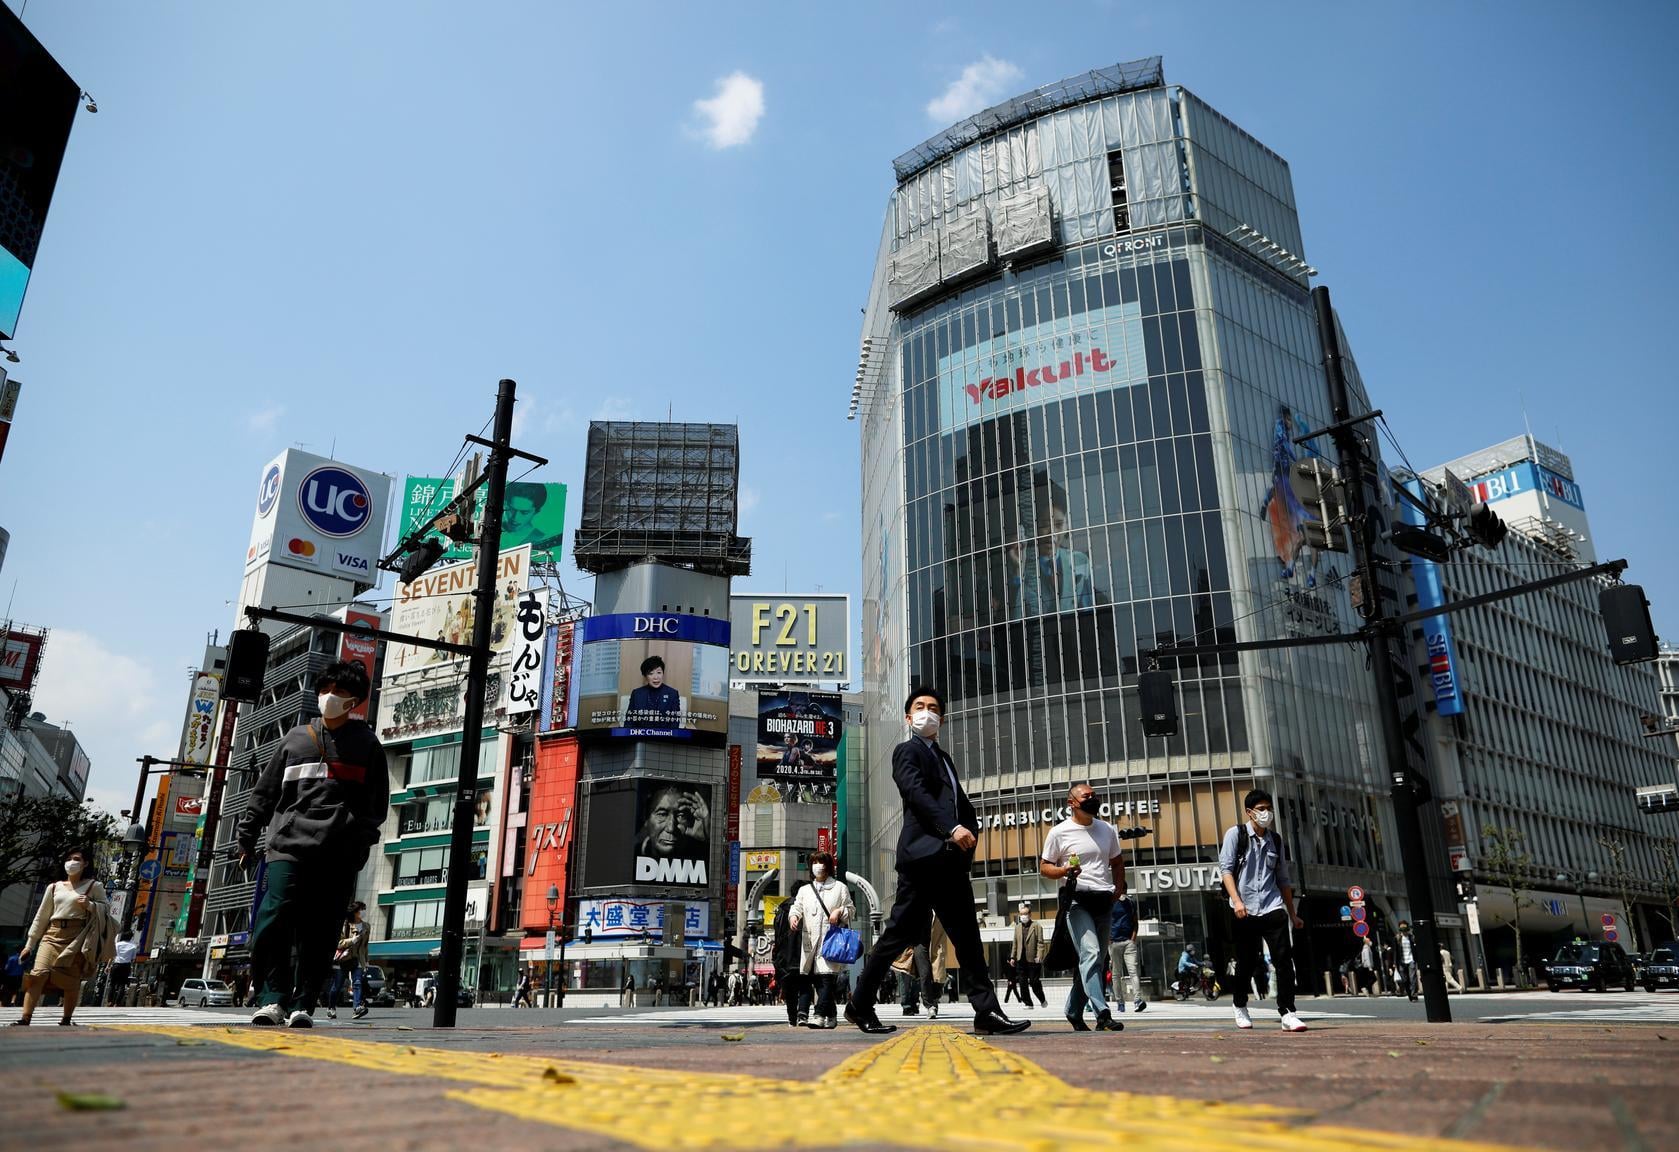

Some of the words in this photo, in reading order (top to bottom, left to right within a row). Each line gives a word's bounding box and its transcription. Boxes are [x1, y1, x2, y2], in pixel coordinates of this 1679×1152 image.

[1103, 235, 1163, 257] QFRONT
[964, 347, 1118, 405] Yakult
[338, 553, 368, 570] VISA
[401, 554, 521, 604] SEVENTEN
[633, 617, 679, 634] DHC
[752, 604, 817, 646] F21
[509, 592, 545, 708] もんじゃ
[823, 651, 844, 673] 21
[1426, 632, 1456, 700] SEIBU
[766, 719, 814, 734] BIOHAZARD
[976, 806, 1073, 829] STARBUCKS
[1097, 799, 1160, 818] OFFEE
[635, 856, 708, 884] DMM
[1141, 866, 1222, 889] TSUTA
